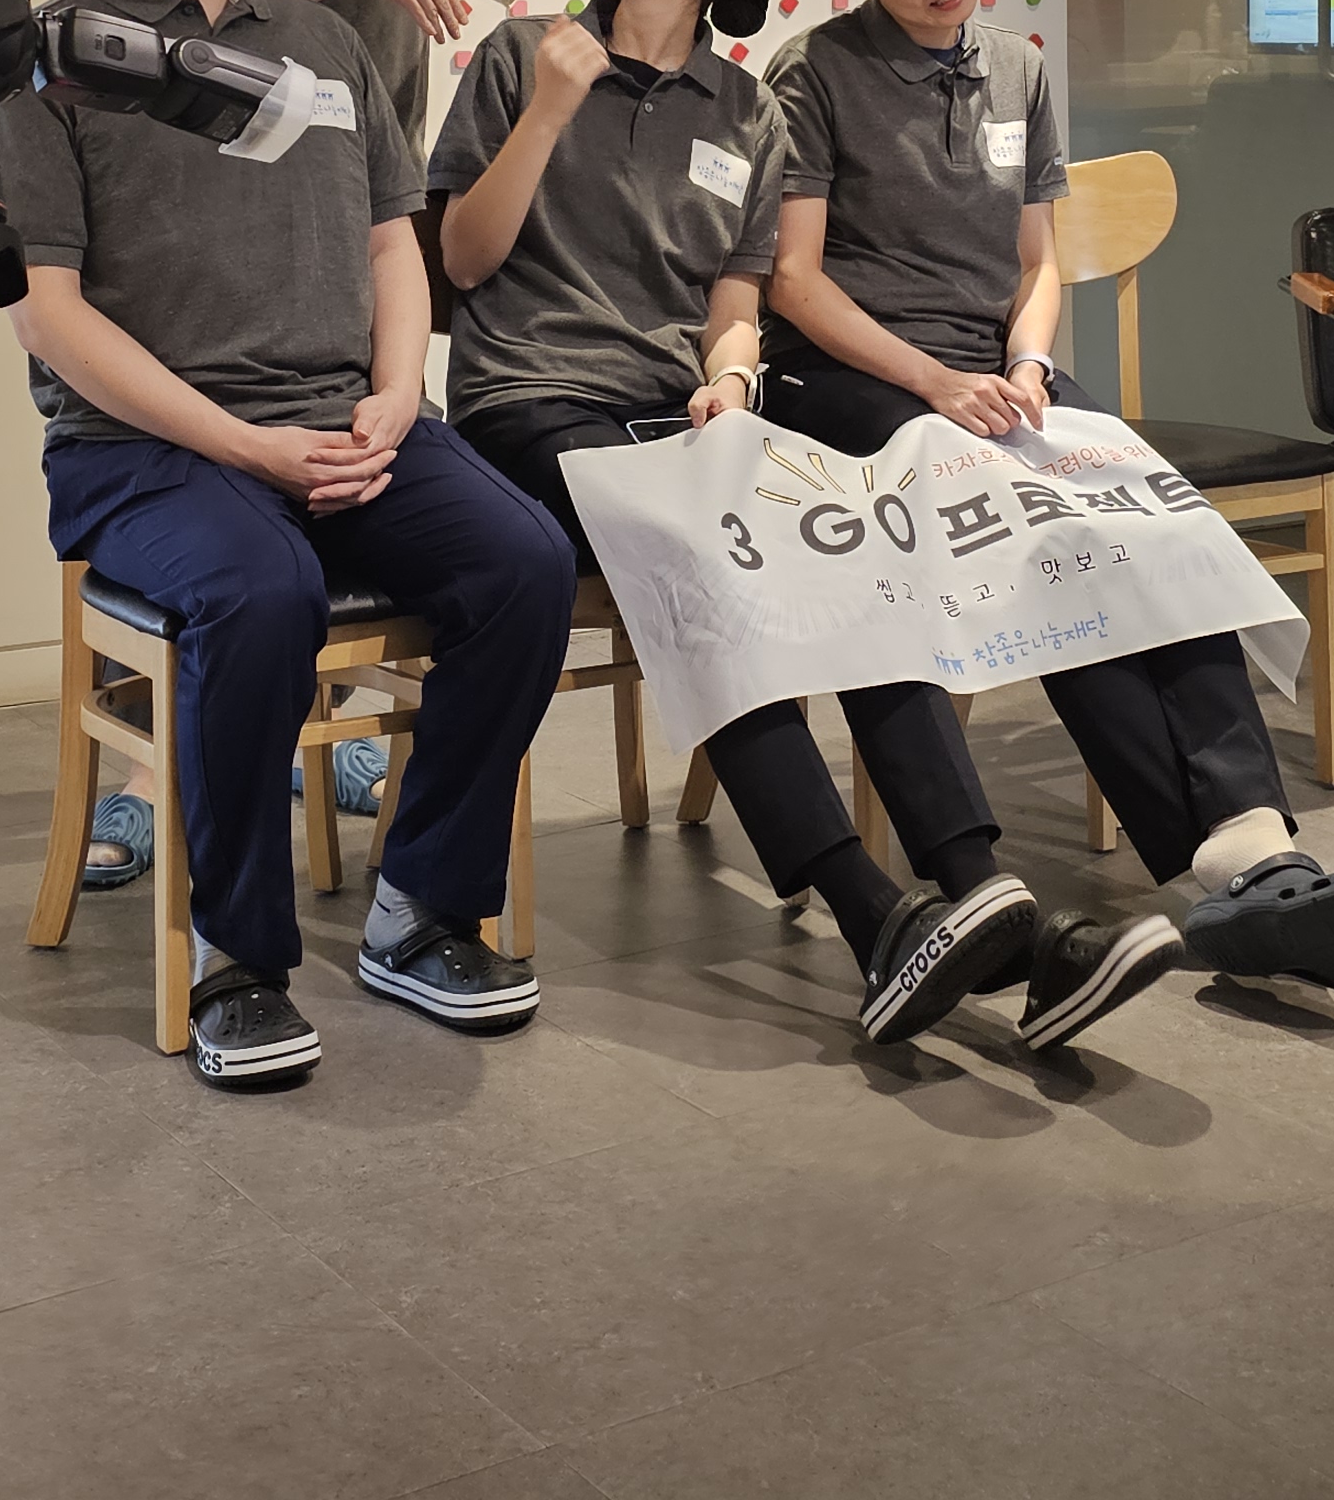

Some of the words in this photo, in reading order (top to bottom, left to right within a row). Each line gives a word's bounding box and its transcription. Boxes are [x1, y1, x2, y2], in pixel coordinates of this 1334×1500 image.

[720, 512, 764, 571] 3
[799, 493, 917, 555] GO
[936, 471, 1217, 558] 프로젝트
[972, 610, 1109, 669] 참좋은나눔재단
[899, 925, 955, 993] crocs
